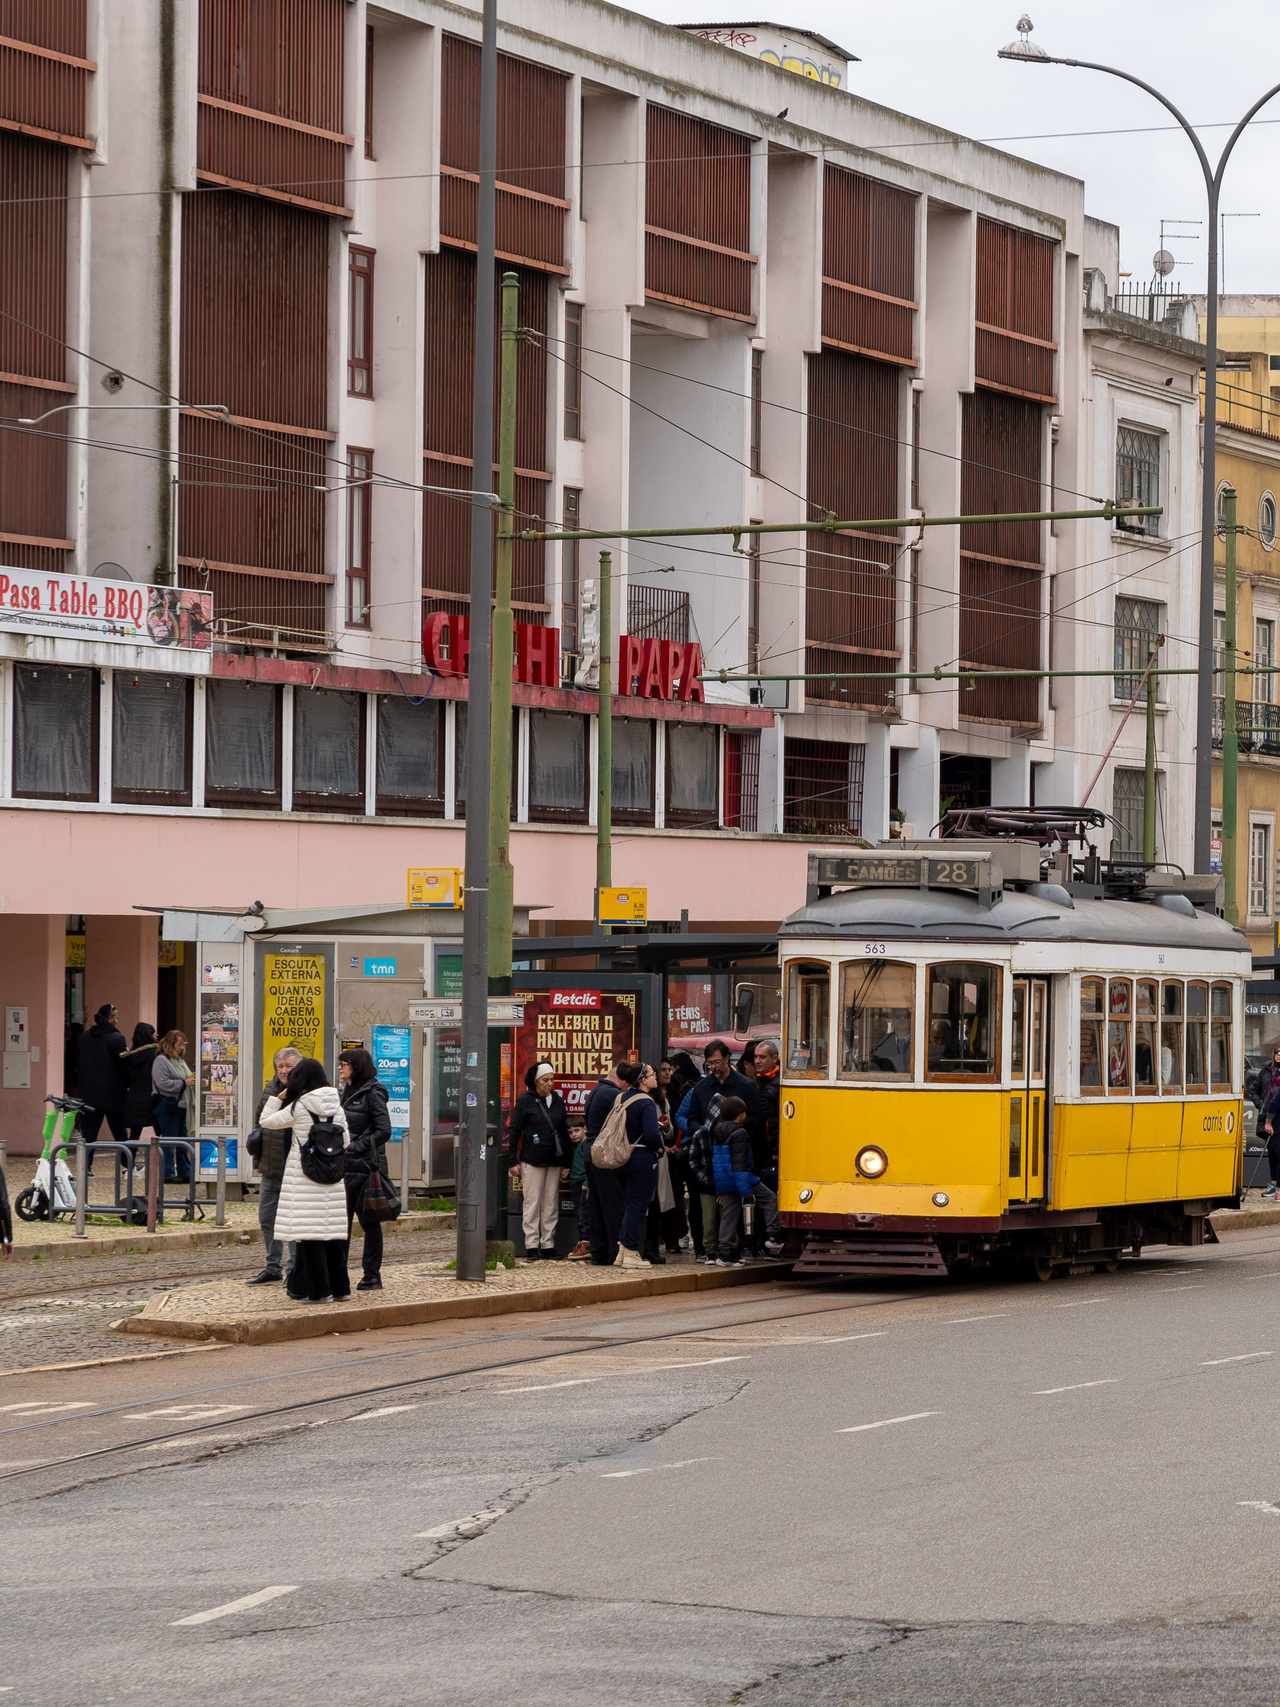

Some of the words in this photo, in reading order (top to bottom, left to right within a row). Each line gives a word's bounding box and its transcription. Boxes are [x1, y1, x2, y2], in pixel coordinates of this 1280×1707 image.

[0, 574, 41, 611] Pasa
[46, 579, 98, 617] Table
[104, 586, 143, 630] BBQ
[619, 634, 705, 703] PAPA
[847, 865, 916, 881] CAMÕES
[936, 862, 968, 883] 28
[864, 943, 886, 954] 563
[274, 959, 318, 970] ESCUTA
[371, 963, 395, 974] tmn
[270, 969, 322, 980] EXTERNA
[269, 986, 322, 996] QUANTAS
[277, 997, 313, 1006] IDEIAS
[553, 993, 598, 1006] Betclic
[275, 1006, 315, 1016] CABEM
[675, 1004, 701, 1020] TÉNIS
[1245, 1003, 1258, 1014] Kia
[1260, 1005, 1279, 1014] EV3
[269, 1017, 285, 1027] NO
[288, 1017, 320, 1027] NOVO
[538, 1014, 600, 1032] CELEBRA
[604, 1015, 614, 1031] O
[271, 1027, 318, 1037] MUSEU?
[536, 1032, 567, 1049] ANO
[572, 1032, 613, 1049] NOVO
[378, 1059, 399, 1068] 20GB
[536, 1048, 613, 1075] CHINÊS
[391, 1106, 409, 1114] 40GB
[1203, 1109, 1223, 1132] carris
